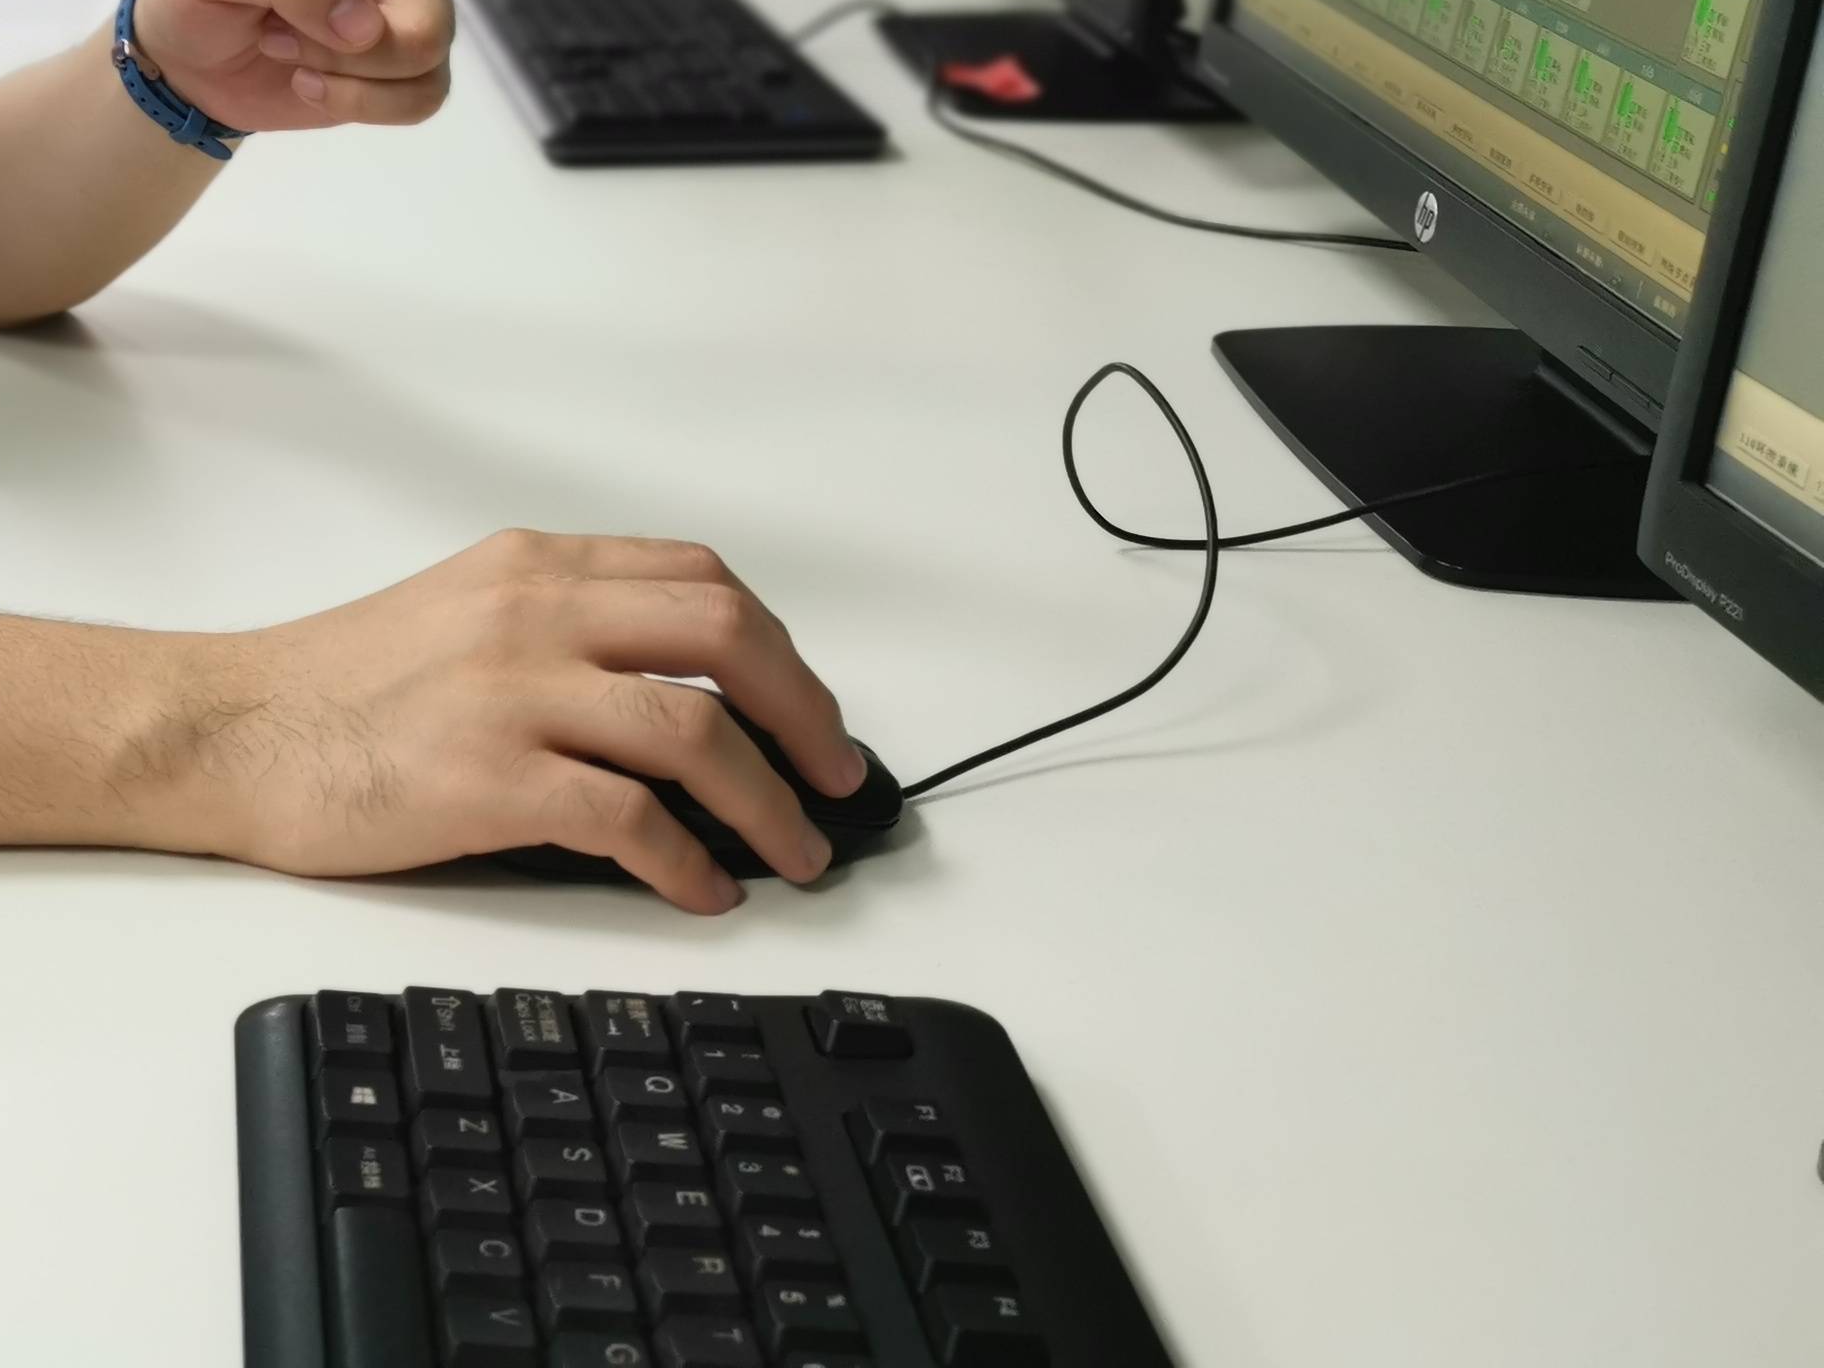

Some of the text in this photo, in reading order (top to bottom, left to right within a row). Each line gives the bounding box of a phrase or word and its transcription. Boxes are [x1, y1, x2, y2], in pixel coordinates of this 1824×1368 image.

[1416, 195, 1436, 238] hp
[514, 993, 537, 1042] Caps Lock
[704, 1049, 725, 1058] 1
[645, 1076, 674, 1093] Q
[550, 1088, 579, 1104] A
[721, 1103, 744, 1116] 2
[914, 1105, 937, 1122] F1
[459, 1118, 488, 1133] Z
[658, 1133, 688, 1149] W
[563, 1147, 592, 1161] S
[738, 1161, 762, 1173] 3
[941, 1165, 966, 1183] F2
[469, 1178, 498, 1193] X
[676, 1190, 708, 1206] E
[575, 1208, 606, 1226] D
[758, 1224, 781, 1237] 4
[967, 1230, 991, 1249] F3
[479, 1239, 511, 1257] C
[692, 1257, 725, 1274] R
[588, 1274, 622, 1289] F
[779, 1290, 807, 1304] 5
[994, 1296, 1019, 1316] F4
[489, 1308, 522, 1326] V
[713, 1328, 744, 1343] T
[605, 1343, 640, 1364] G
